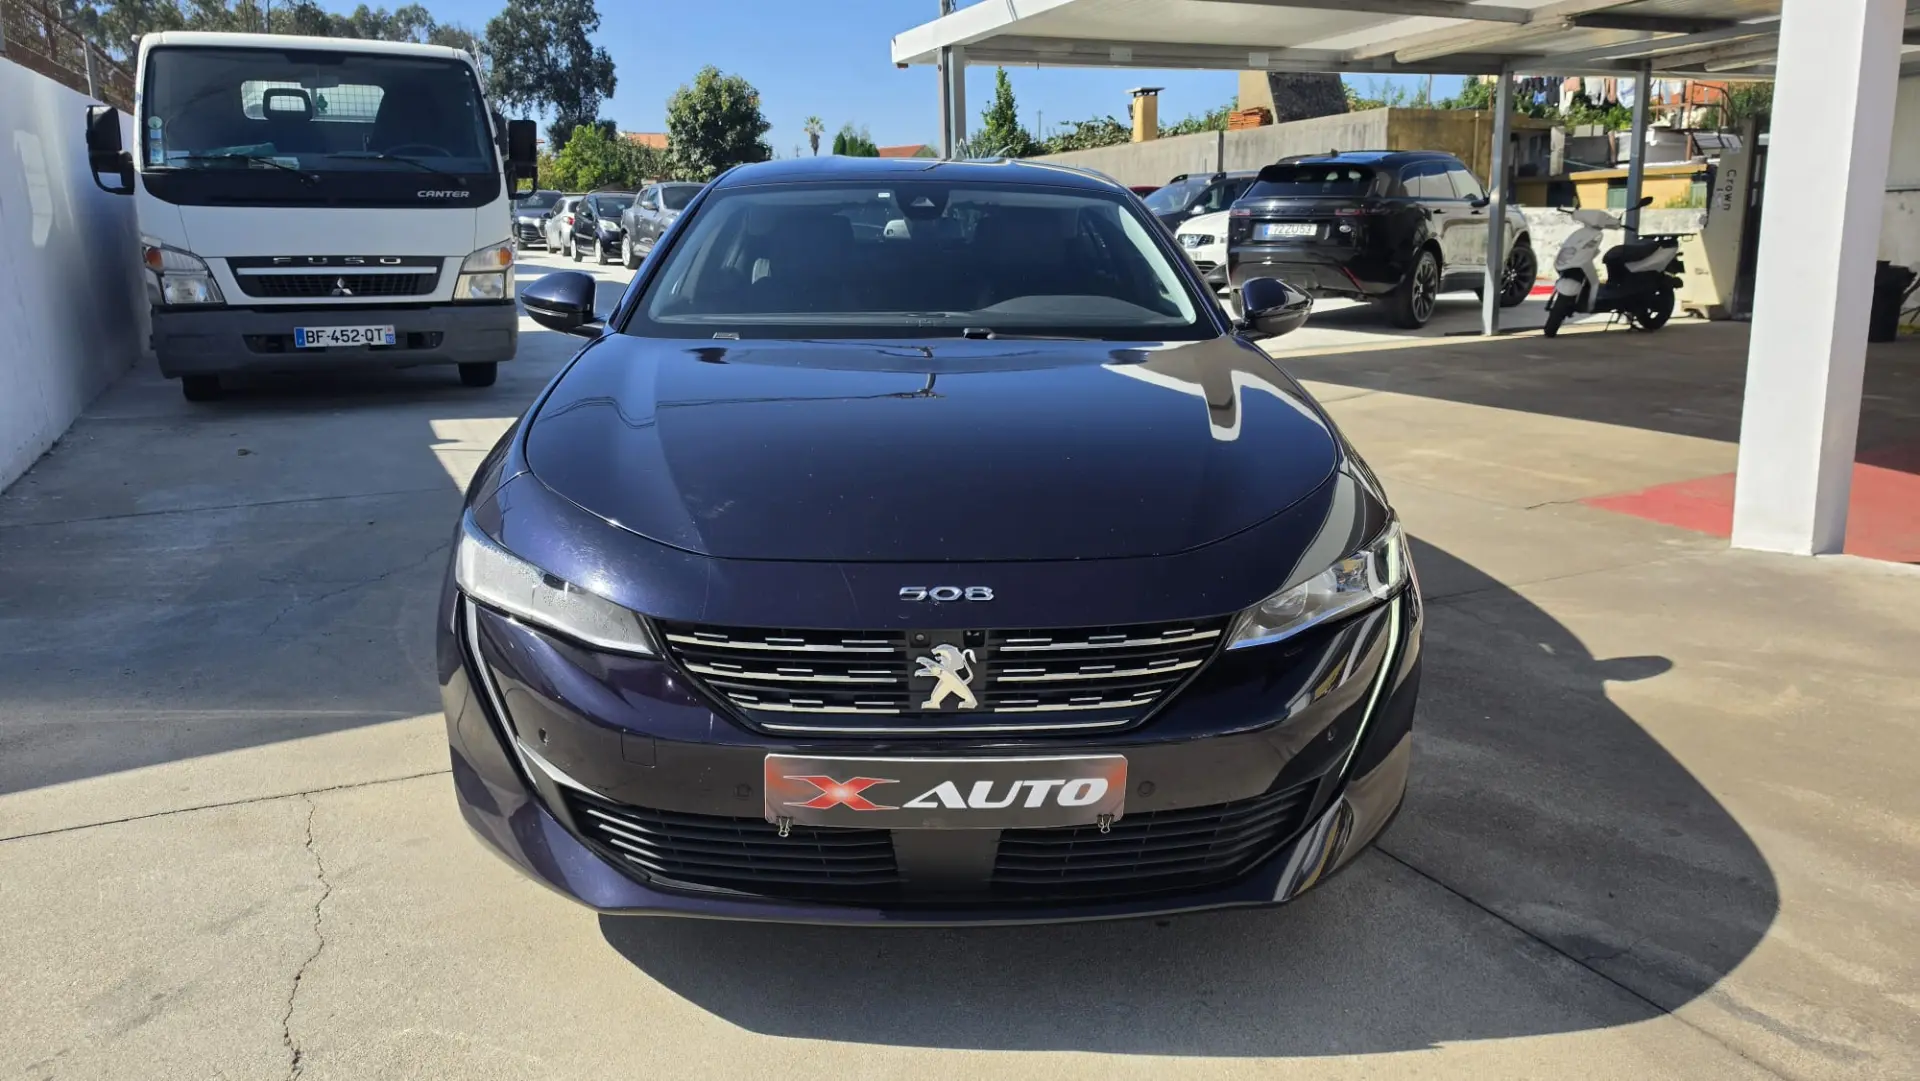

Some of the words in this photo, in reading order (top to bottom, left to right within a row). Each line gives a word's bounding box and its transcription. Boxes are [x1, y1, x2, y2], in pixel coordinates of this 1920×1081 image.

[417, 190, 470, 198] CANTER
[1723, 169, 1737, 211] Crown
[273, 257, 402, 265] FUSO
[305, 328, 383, 344] BF-452-QT
[899, 586, 994, 601] 508
[783, 775, 900, 811] X
[902, 778, 1109, 809] AUTO
